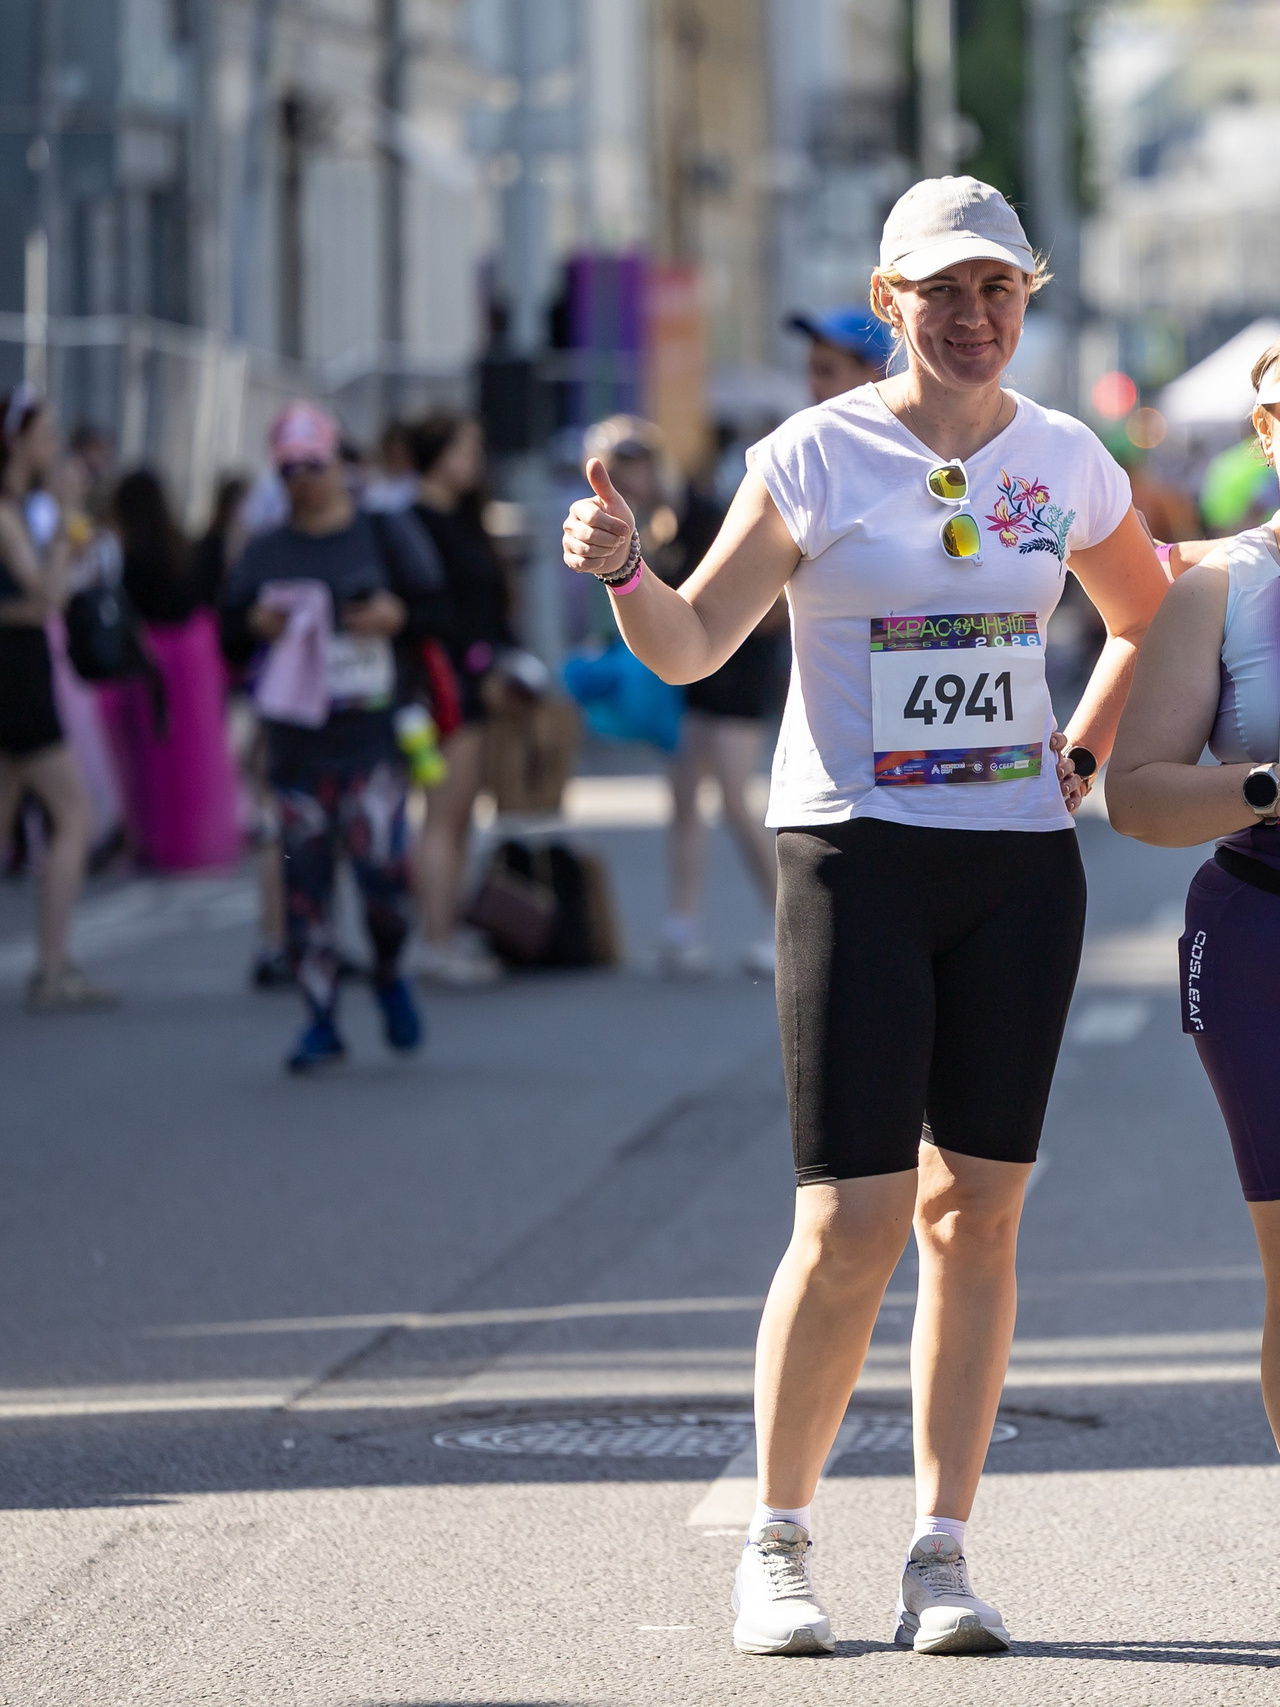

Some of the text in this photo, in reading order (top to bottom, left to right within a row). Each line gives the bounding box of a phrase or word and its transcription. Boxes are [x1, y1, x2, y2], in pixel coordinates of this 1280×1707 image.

[887, 614, 1026, 640] КРАСОЧНЫЙ
[888, 640, 966, 649] ЗАБЕГ
[975, 635, 1038, 648] 2026
[904, 671, 1013, 726] 4941
[1188, 930, 1207, 1031] COSLEAF
